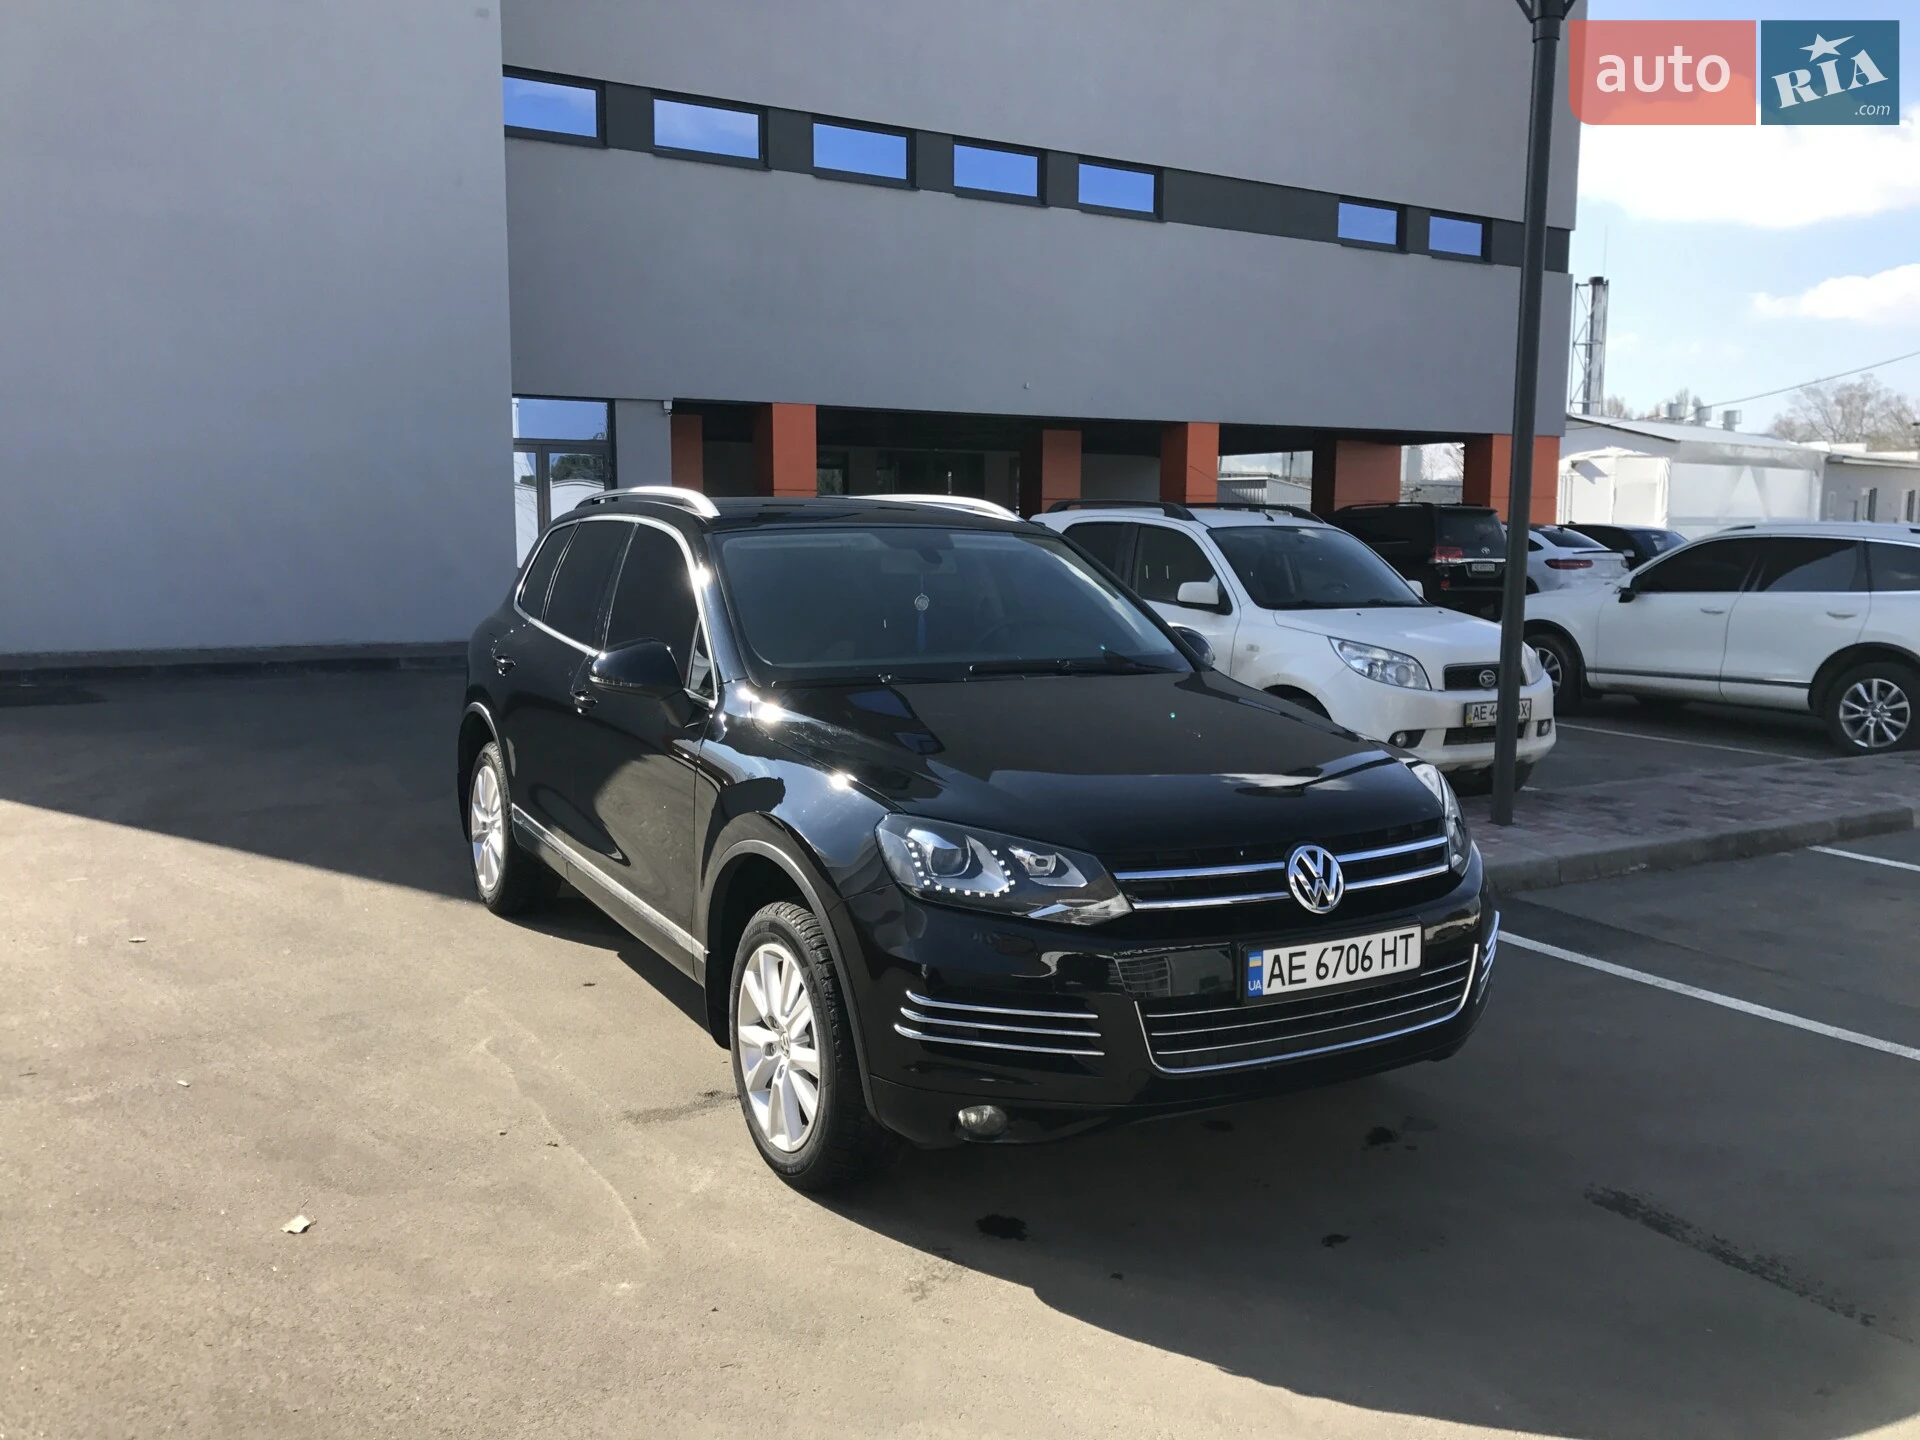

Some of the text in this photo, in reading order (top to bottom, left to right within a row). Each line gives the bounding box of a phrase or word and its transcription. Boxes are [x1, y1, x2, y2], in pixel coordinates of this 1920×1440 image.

[1473, 705, 1487, 721] AE
[1267, 933, 1415, 988] AE 6706 HT
[1248, 979, 1262, 992] UA
